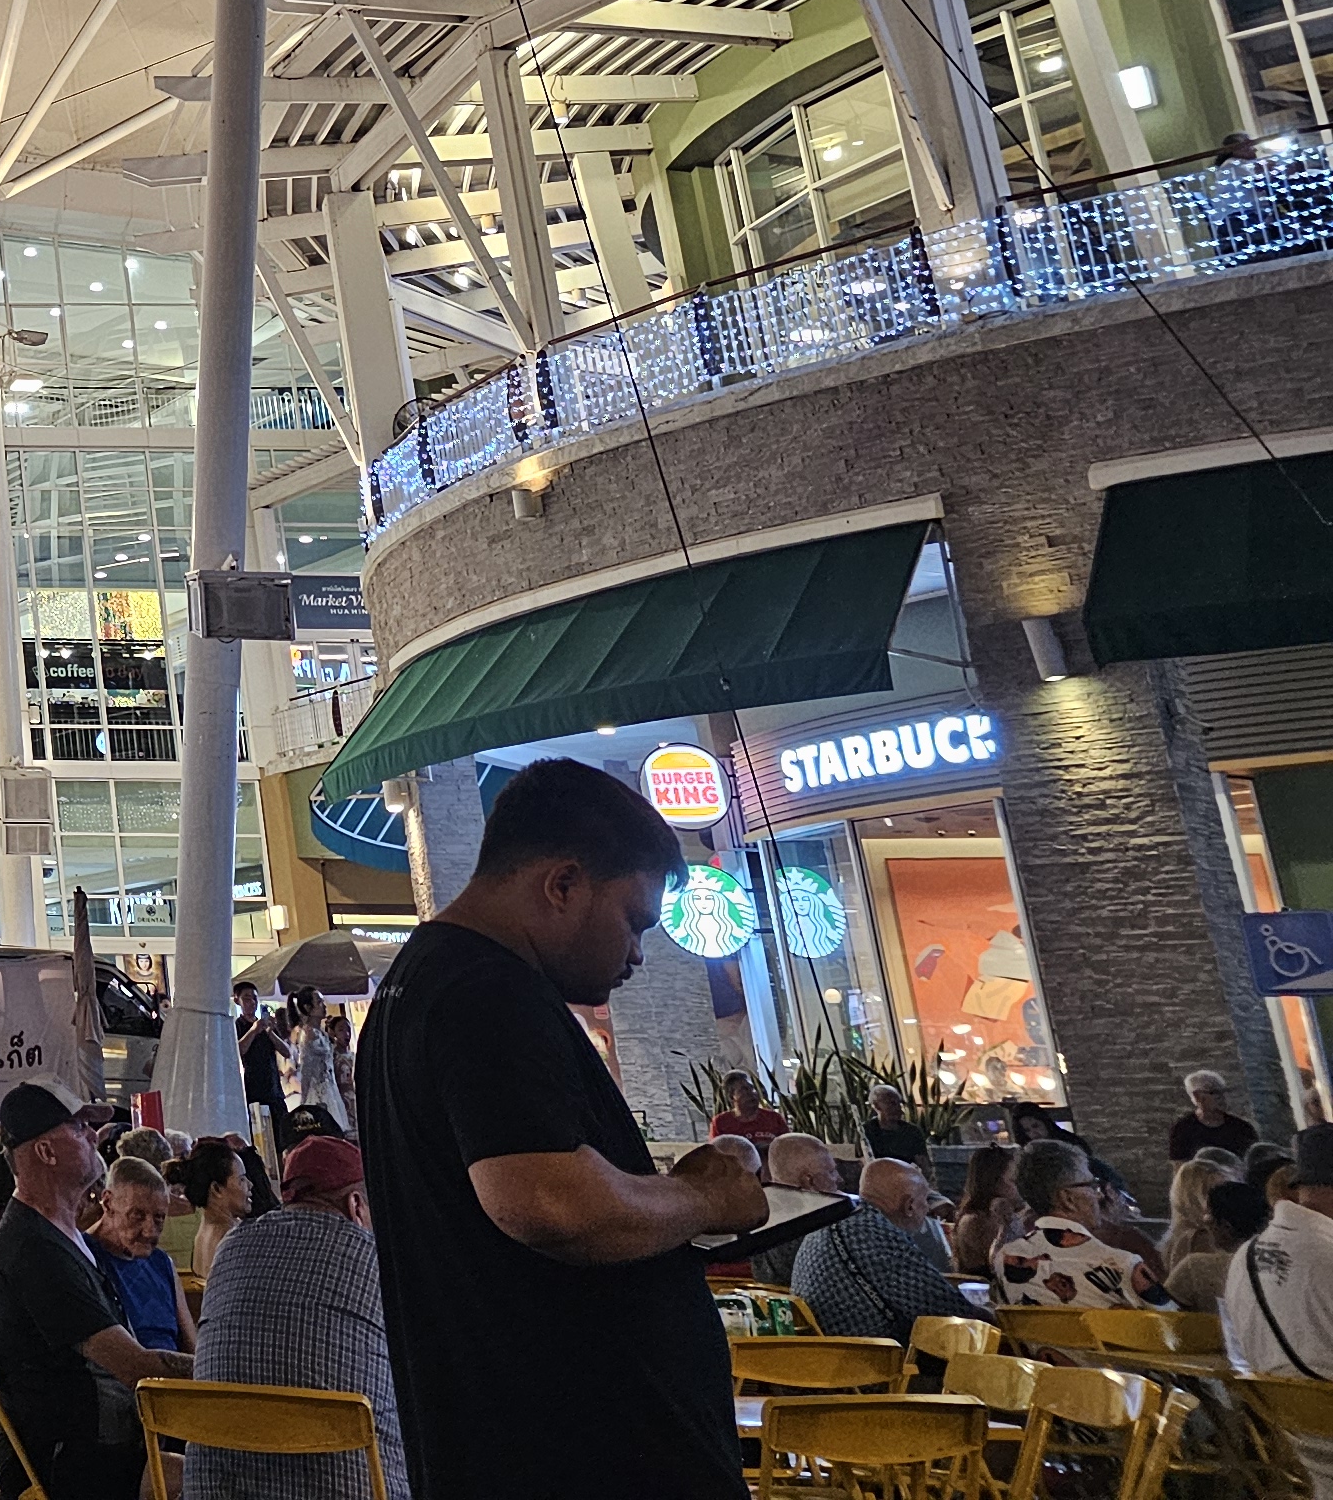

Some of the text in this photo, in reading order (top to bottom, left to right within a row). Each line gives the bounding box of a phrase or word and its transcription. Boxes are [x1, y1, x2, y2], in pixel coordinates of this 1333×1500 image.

[299, 593, 349, 606] Market
[49, 664, 95, 678] coffee
[780, 714, 997, 793] STARBUCK
[651, 771, 715, 787] BURGER
[655, 786, 719, 806] KING
